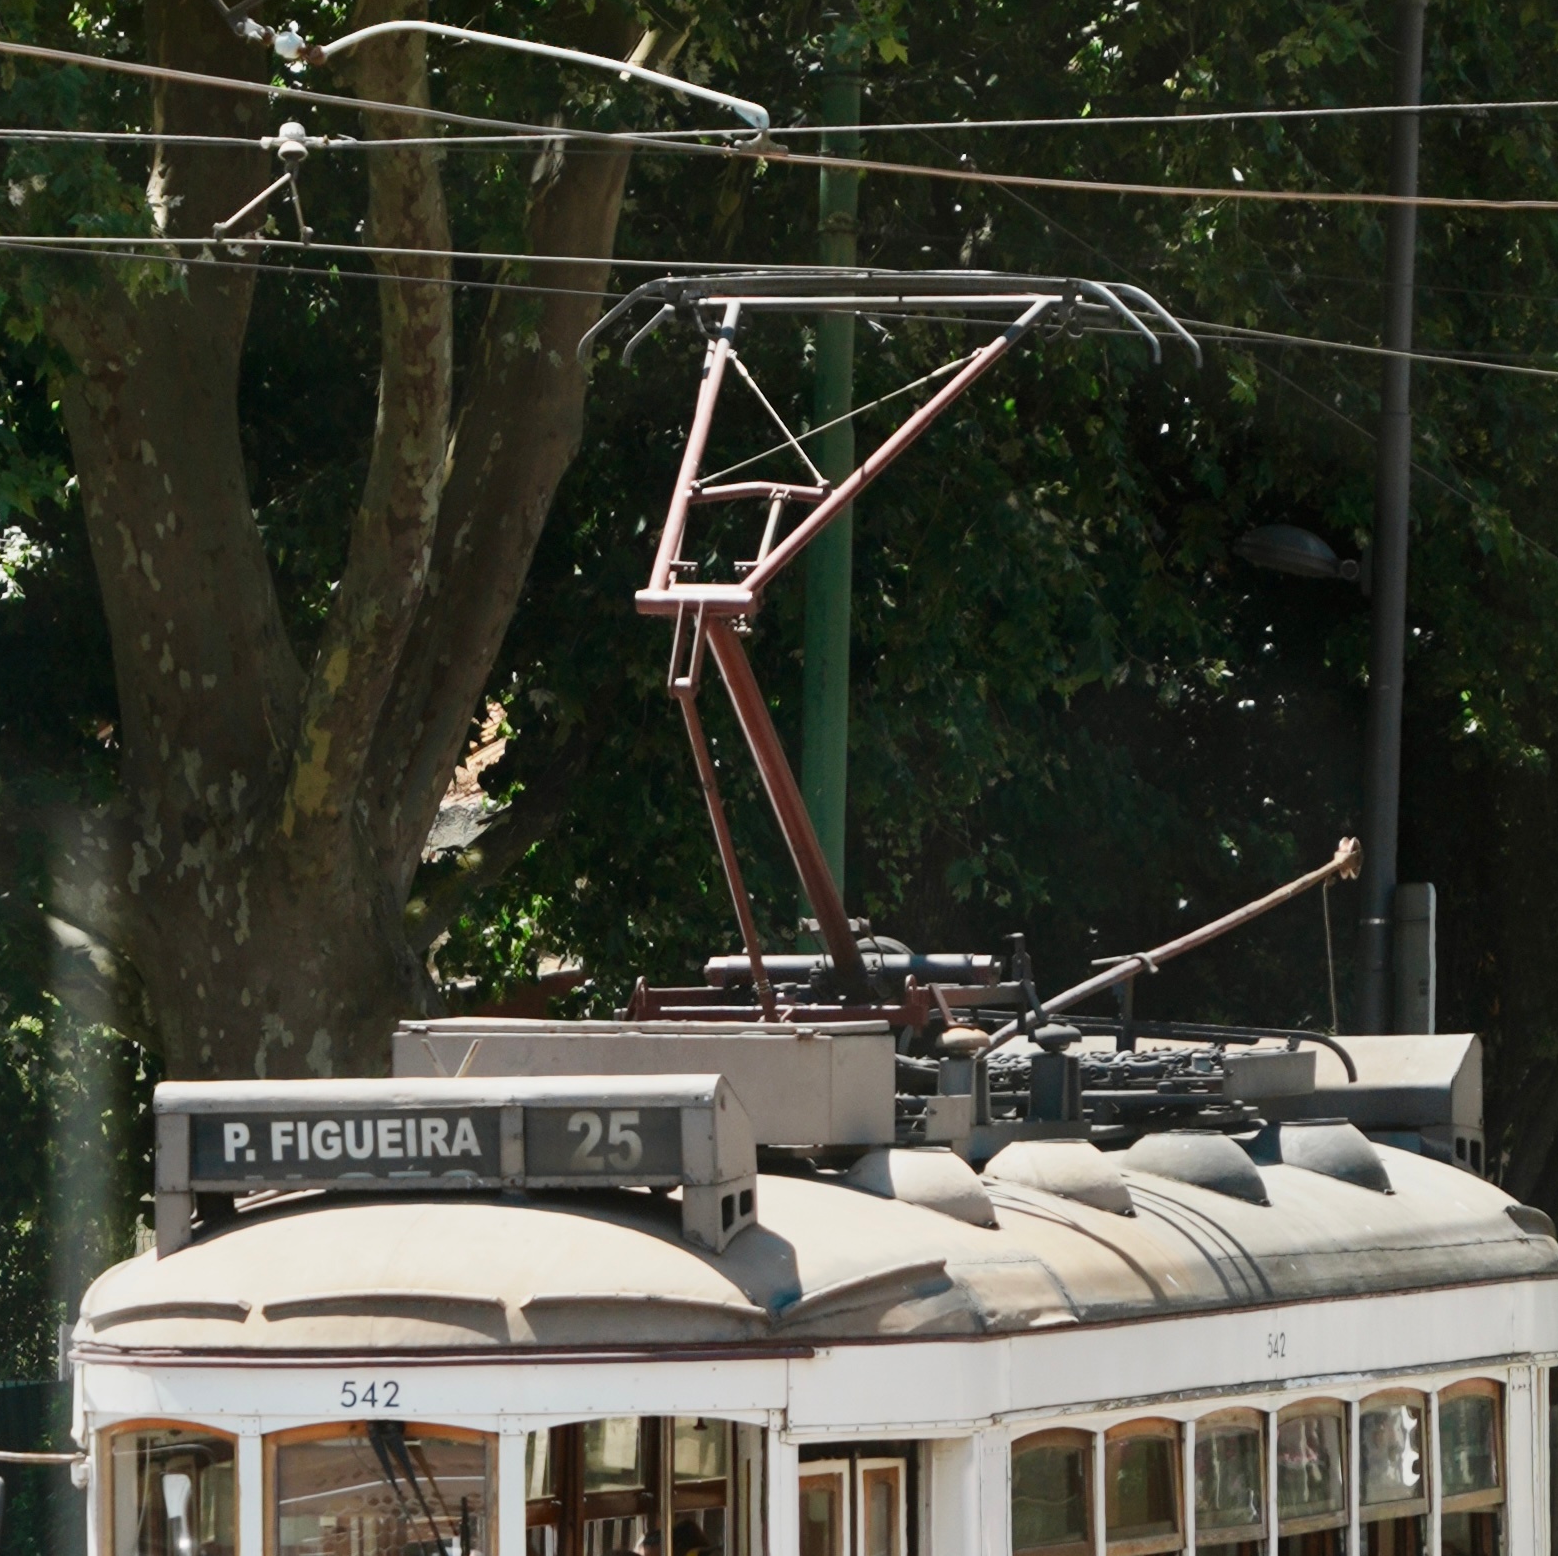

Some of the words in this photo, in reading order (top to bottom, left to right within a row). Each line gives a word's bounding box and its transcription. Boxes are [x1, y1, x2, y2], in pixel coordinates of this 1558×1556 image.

[223, 1122, 255, 1162] P.
[271, 1117, 482, 1160] FIGUEIRA
[566, 1110, 643, 1172] 25
[1267, 1332, 1286, 1359] 542
[340, 1381, 401, 1409] 542
